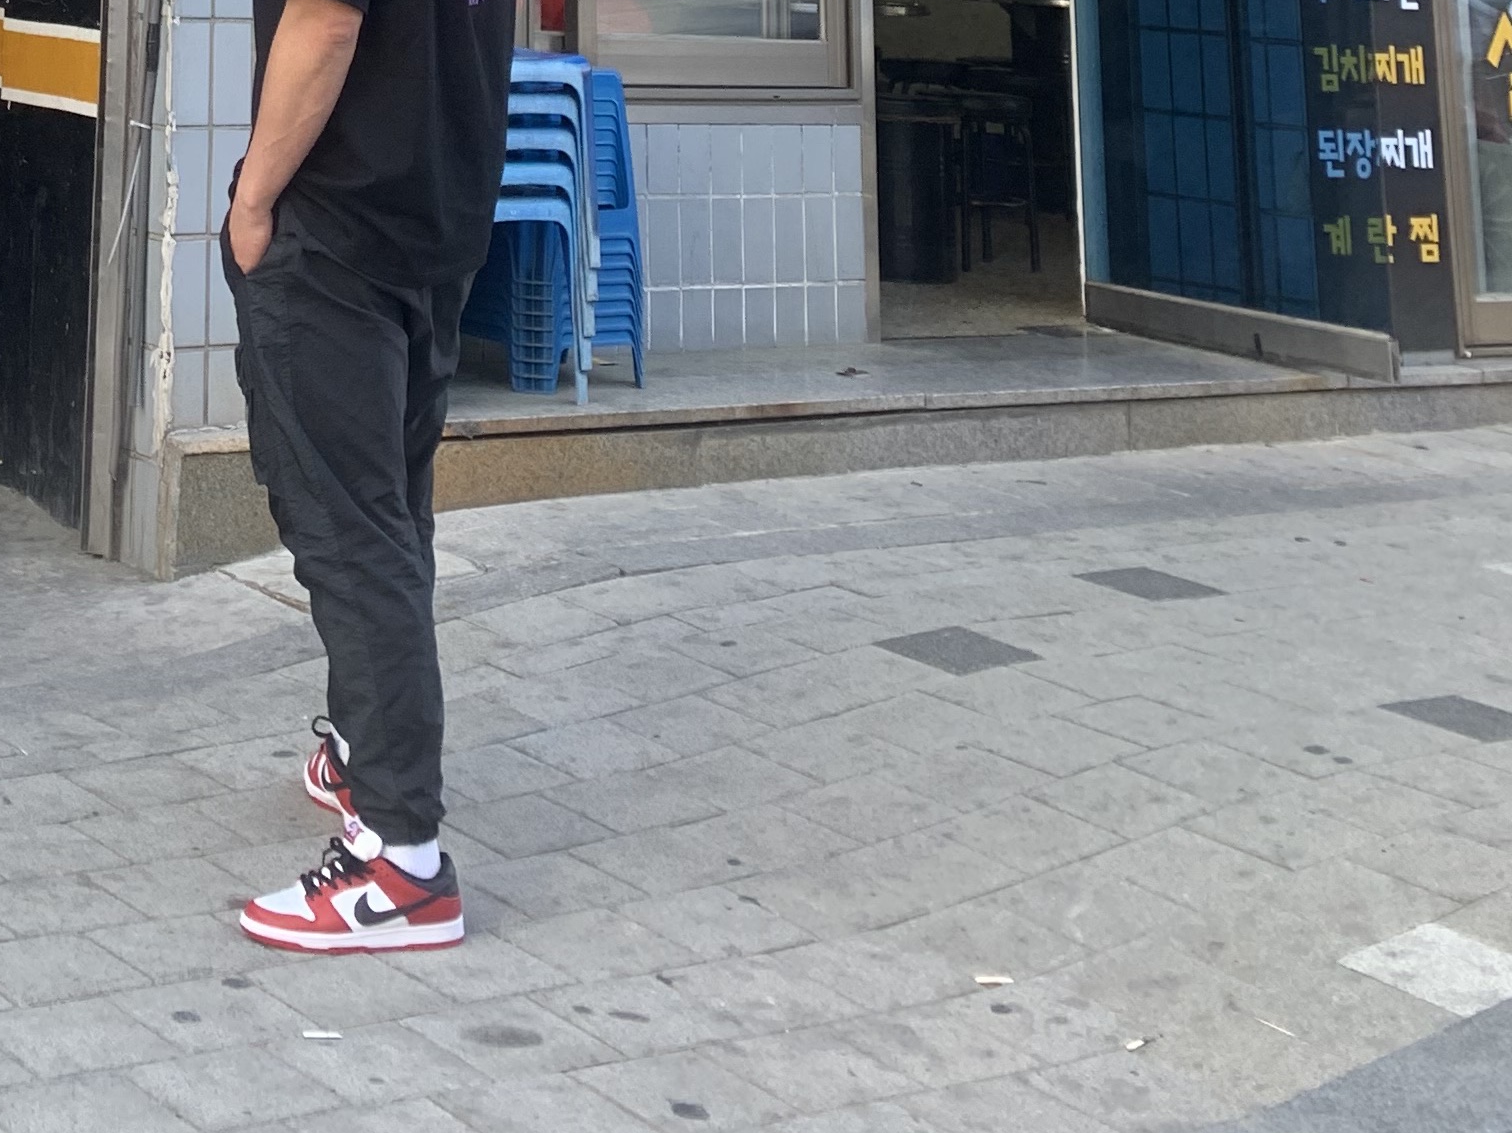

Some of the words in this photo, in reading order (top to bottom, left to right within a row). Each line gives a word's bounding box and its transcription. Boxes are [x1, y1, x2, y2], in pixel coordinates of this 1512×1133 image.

[1314, 44, 1426, 93] 김치찌개
[1318, 129, 1434, 180] 된장찌개
[1323, 214, 1441, 264] 계란찜
